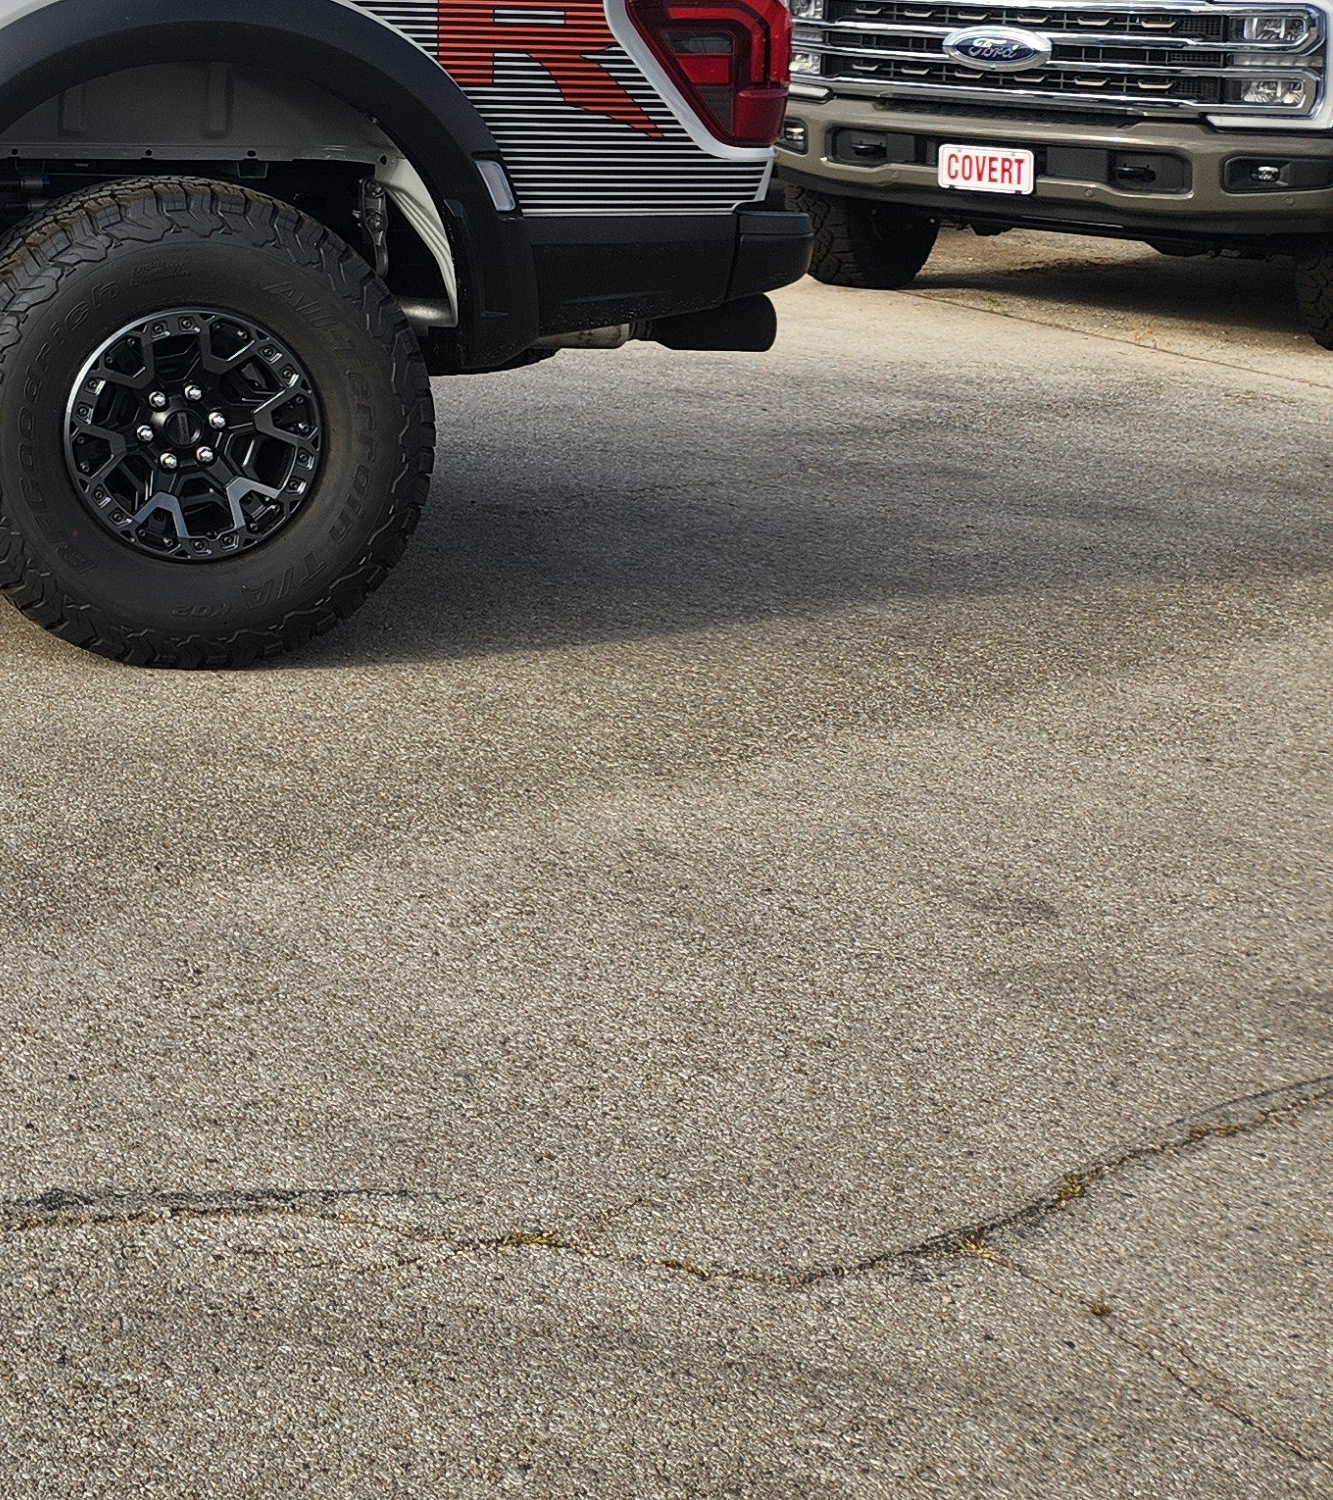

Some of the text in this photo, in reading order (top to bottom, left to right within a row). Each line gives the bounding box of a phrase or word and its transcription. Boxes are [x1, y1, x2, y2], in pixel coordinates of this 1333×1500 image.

[968, 38, 1019, 58] Ford
[947, 153, 1025, 185] COVERT
[17, 279, 119, 574] BFGoodrich
[242, 551, 328, 610] T/A
